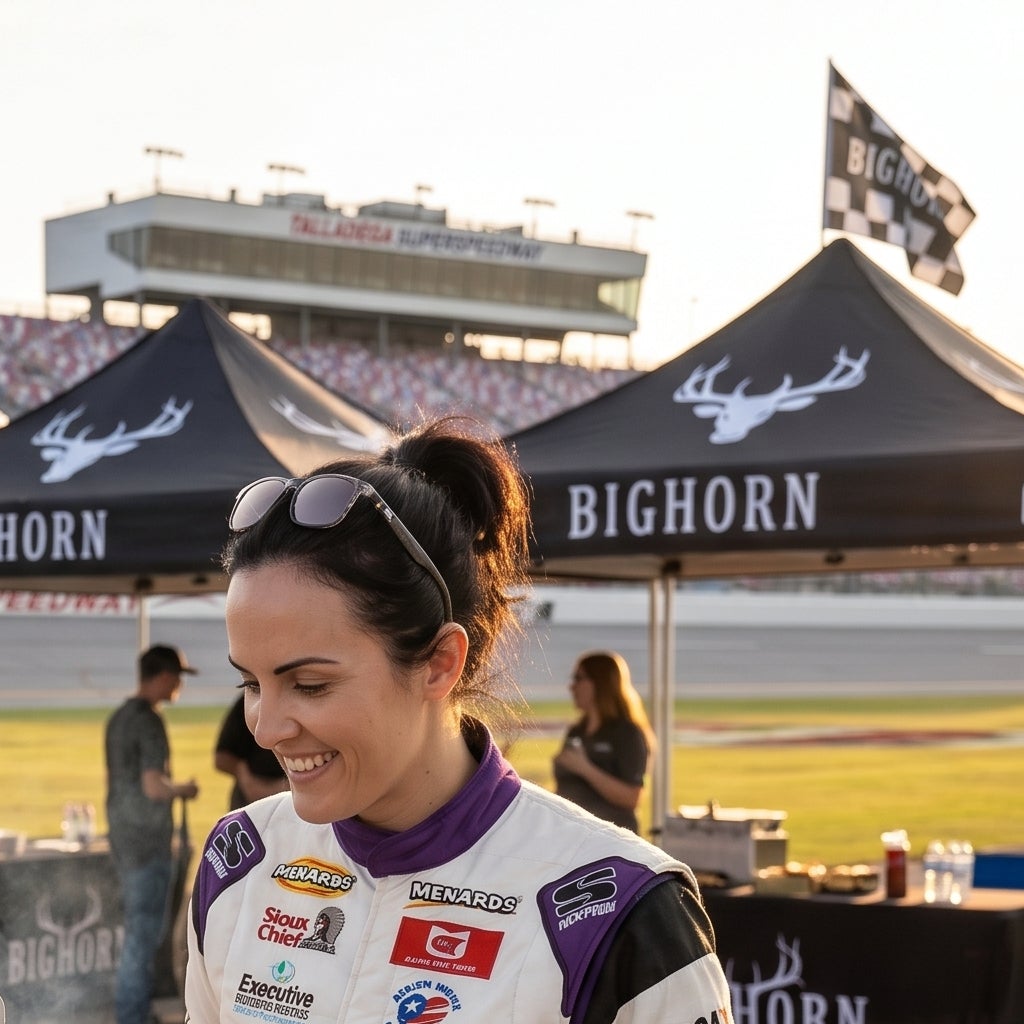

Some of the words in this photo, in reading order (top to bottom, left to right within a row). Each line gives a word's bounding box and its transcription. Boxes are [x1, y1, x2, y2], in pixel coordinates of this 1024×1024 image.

[567, 472, 820, 540] BIGHORN
[272, 863, 353, 892] MENARDS
[409, 881, 518, 915] MENARDS
[262, 906, 311, 932] Sioux
[257, 924, 305, 949] Chief
[238, 973, 314, 1009] Executive
